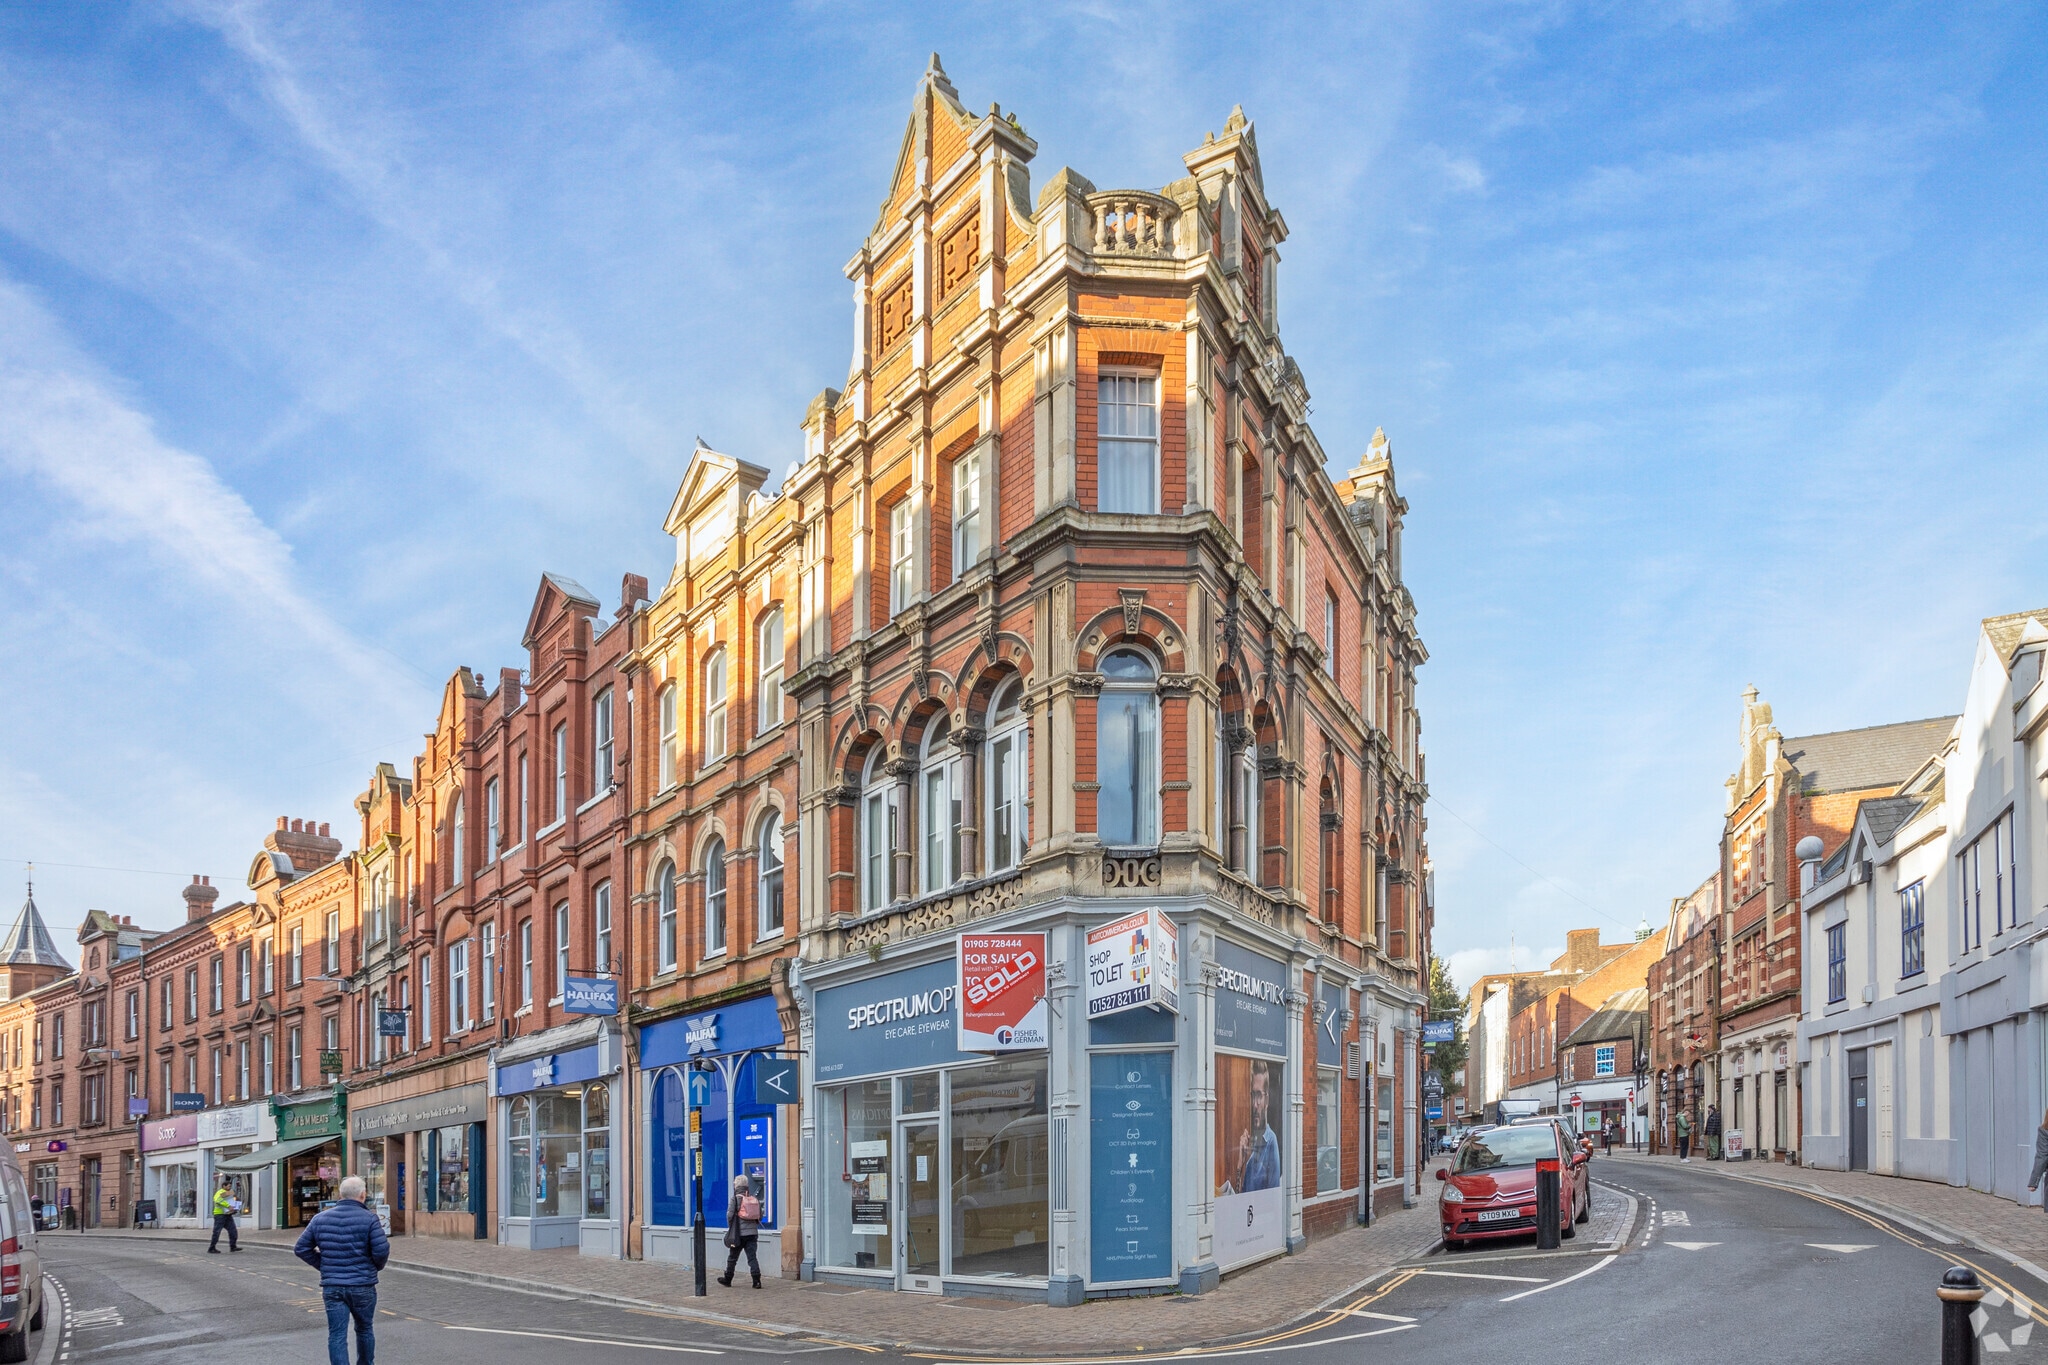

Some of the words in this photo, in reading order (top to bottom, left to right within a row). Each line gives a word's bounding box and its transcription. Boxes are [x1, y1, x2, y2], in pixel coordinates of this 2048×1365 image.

[964, 940, 989, 948] 01905
[990, 939, 1022, 948] 728444
[964, 954, 988, 964] FOR
[1089, 950, 1111, 968] SHOP
[1131, 952, 1147, 966] AMT
[967, 950, 1037, 1004] SOLD
[1090, 969, 1105, 987] TO
[1106, 963, 1124, 983] LET
[567, 990, 615, 1002] HALIFAX
[1092, 994, 1116, 1014] 01527
[1117, 991, 1132, 1007] 821
[1134, 986, 1148, 1003] 111
[685, 1025, 718, 1045] HALIFAX
[885, 1029, 897, 1040] EYE
[918, 1019, 950, 1034] EYEWEAR
[1014, 1029, 1038, 1037] FISHER
[1424, 1027, 1452, 1036] HALIFAX
[1014, 1036, 1044, 1044] GERMAN
[532, 1064, 553, 1079] HALIFAX
[311, 1113, 329, 1125] MEATS
[158, 1126, 177, 1141] Scope
[1501, 1211, 1517, 1219] MXC
